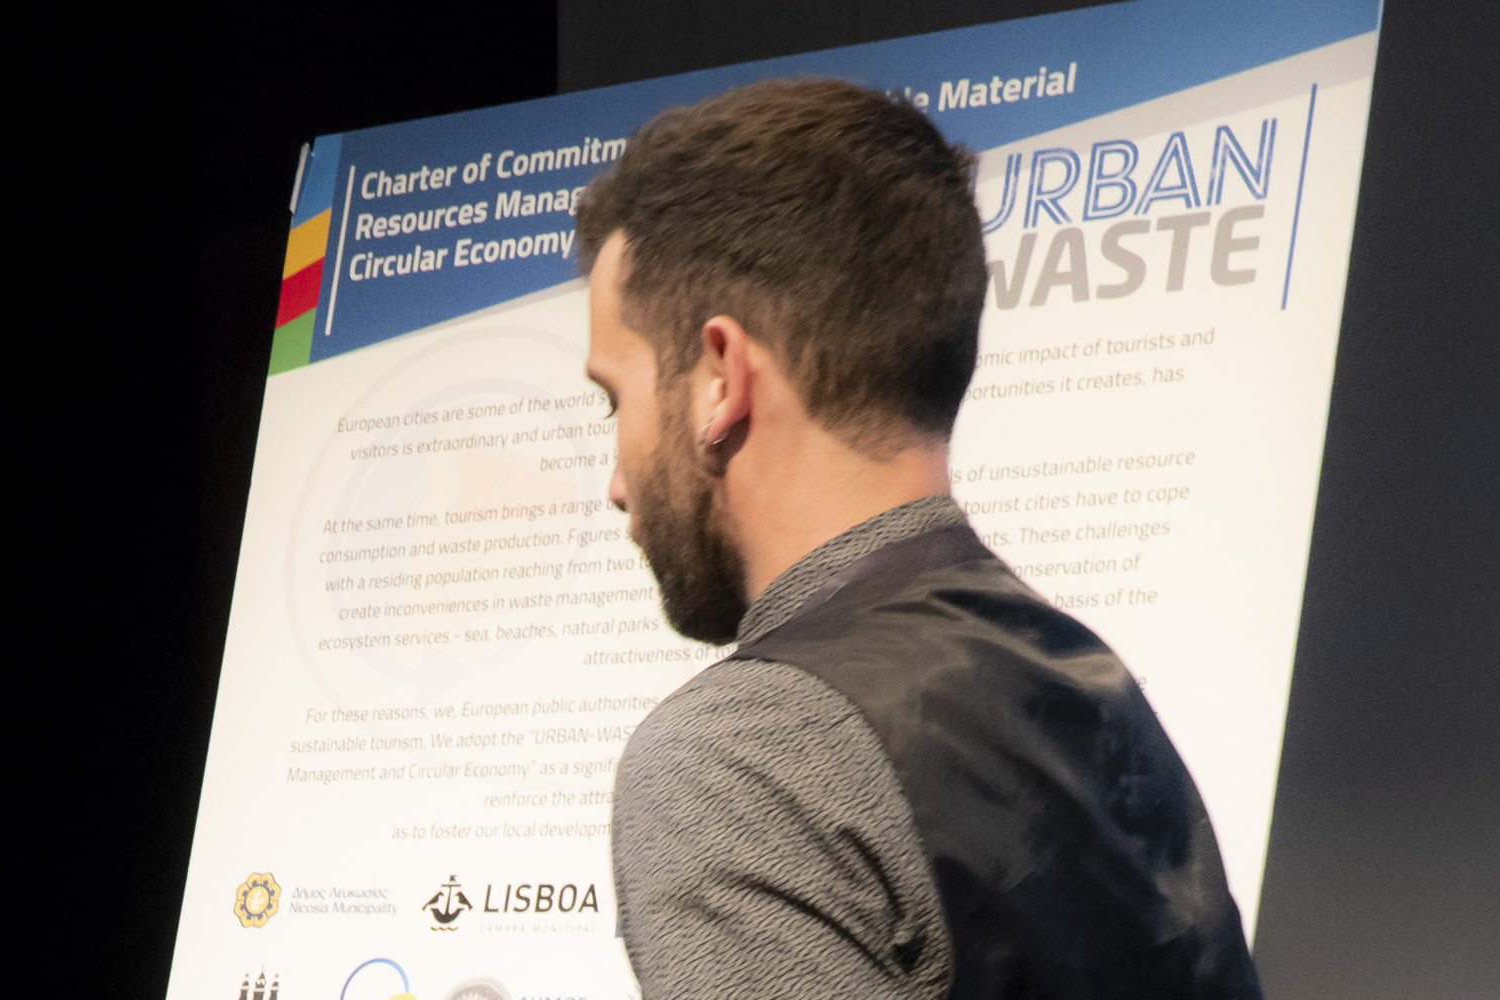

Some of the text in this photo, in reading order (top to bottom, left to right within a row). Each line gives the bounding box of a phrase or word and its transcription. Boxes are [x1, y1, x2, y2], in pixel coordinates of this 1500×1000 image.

[937, 62, 1078, 111] Material
[361, 164, 457, 200] Charter
[462, 153, 491, 183] of
[974, 118, 1278, 234] URBAN
[355, 201, 487, 241] Resources
[349, 229, 577, 282] Circular Economy
[1019, 342, 1077, 365] impact
[1083, 339, 1102, 358] of
[1107, 333, 1175, 354] tourists
[1180, 327, 1216, 346] and
[1060, 376, 1071, 392] it
[1077, 371, 1146, 390] creates,
[1152, 366, 1184, 383] has
[337, 414, 400, 433] European
[403, 411, 438, 427] cities
[442, 411, 463, 422] are
[467, 407, 505, 420] some
[509, 399, 524, 414] of
[528, 396, 549, 412] the
[351, 443, 398, 461] visitors
[402, 440, 413, 455] is
[417, 432, 508, 454] extraordinary
[512, 428, 538, 445] and
[542, 424, 582, 441] urban
[540, 453, 596, 472] become
[599, 454, 608, 466] a
[967, 464, 986, 482] of
[989, 454, 1112, 480] unsustainable
[1117, 451, 1196, 470] resource
[965, 484, 1190, 515] tourist cities have to cope
[322, 519, 338, 534] At
[341, 519, 362, 533] the
[366, 518, 403, 531] same
[406, 512, 440, 528] time,
[445, 508, 498, 525] tourism
[502, 504, 544, 523] brings
[549, 504, 558, 516] a
[561, 499, 602, 517] range
[1020, 527, 1070, 544] These
[1075, 520, 1171, 541] challenges
[319, 544, 406, 564] consumption
[409, 540, 435, 557] and
[439, 539, 481, 554] waste
[484, 529, 563, 551] production.
[568, 526, 621, 546] Figures
[325, 576, 354, 592] with
[357, 577, 366, 590] a
[369, 570, 422, 590] residing
[426, 568, 499, 586] population
[503, 561, 563, 580] reaching
[567, 558, 601, 572] from
[606, 556, 635, 571] two
[1123, 553, 1142, 571] of
[339, 586, 653, 620] create inconveniences in waste management
[1105, 588, 1123, 606] of
[1128, 588, 1157, 604] the
[318, 633, 390, 652] ecosystem
[394, 629, 449, 646] services
[496, 622, 557, 641] beaches,
[562, 618, 614, 636] natural
[618, 616, 658, 637] parks
[584, 648, 690, 666] attractiveness
[306, 707, 328, 724] For
[331, 707, 369, 722] these
[462, 701, 528, 719] European
[532, 697, 575, 716] public
[579, 695, 660, 712] authorities
[291, 736, 366, 754] sustainable
[431, 732, 452, 749] We
[456, 731, 499, 750] adopt
[502, 730, 524, 746] the
[288, 766, 374, 785] Management
[379, 765, 404, 781] and
[409, 762, 460, 779] Circular
[540, 761, 556, 775] as
[560, 762, 569, 774] a
[484, 791, 547, 808] reinforce
[551, 791, 575, 806] the
[392, 826, 408, 840] as
[412, 824, 426, 839] to
[430, 822, 471, 839] foster
[476, 824, 499, 838] our
[502, 821, 536, 838] local
[289, 902, 398, 917] Nicosia Municipality
[484, 883, 600, 914] LISBOA
